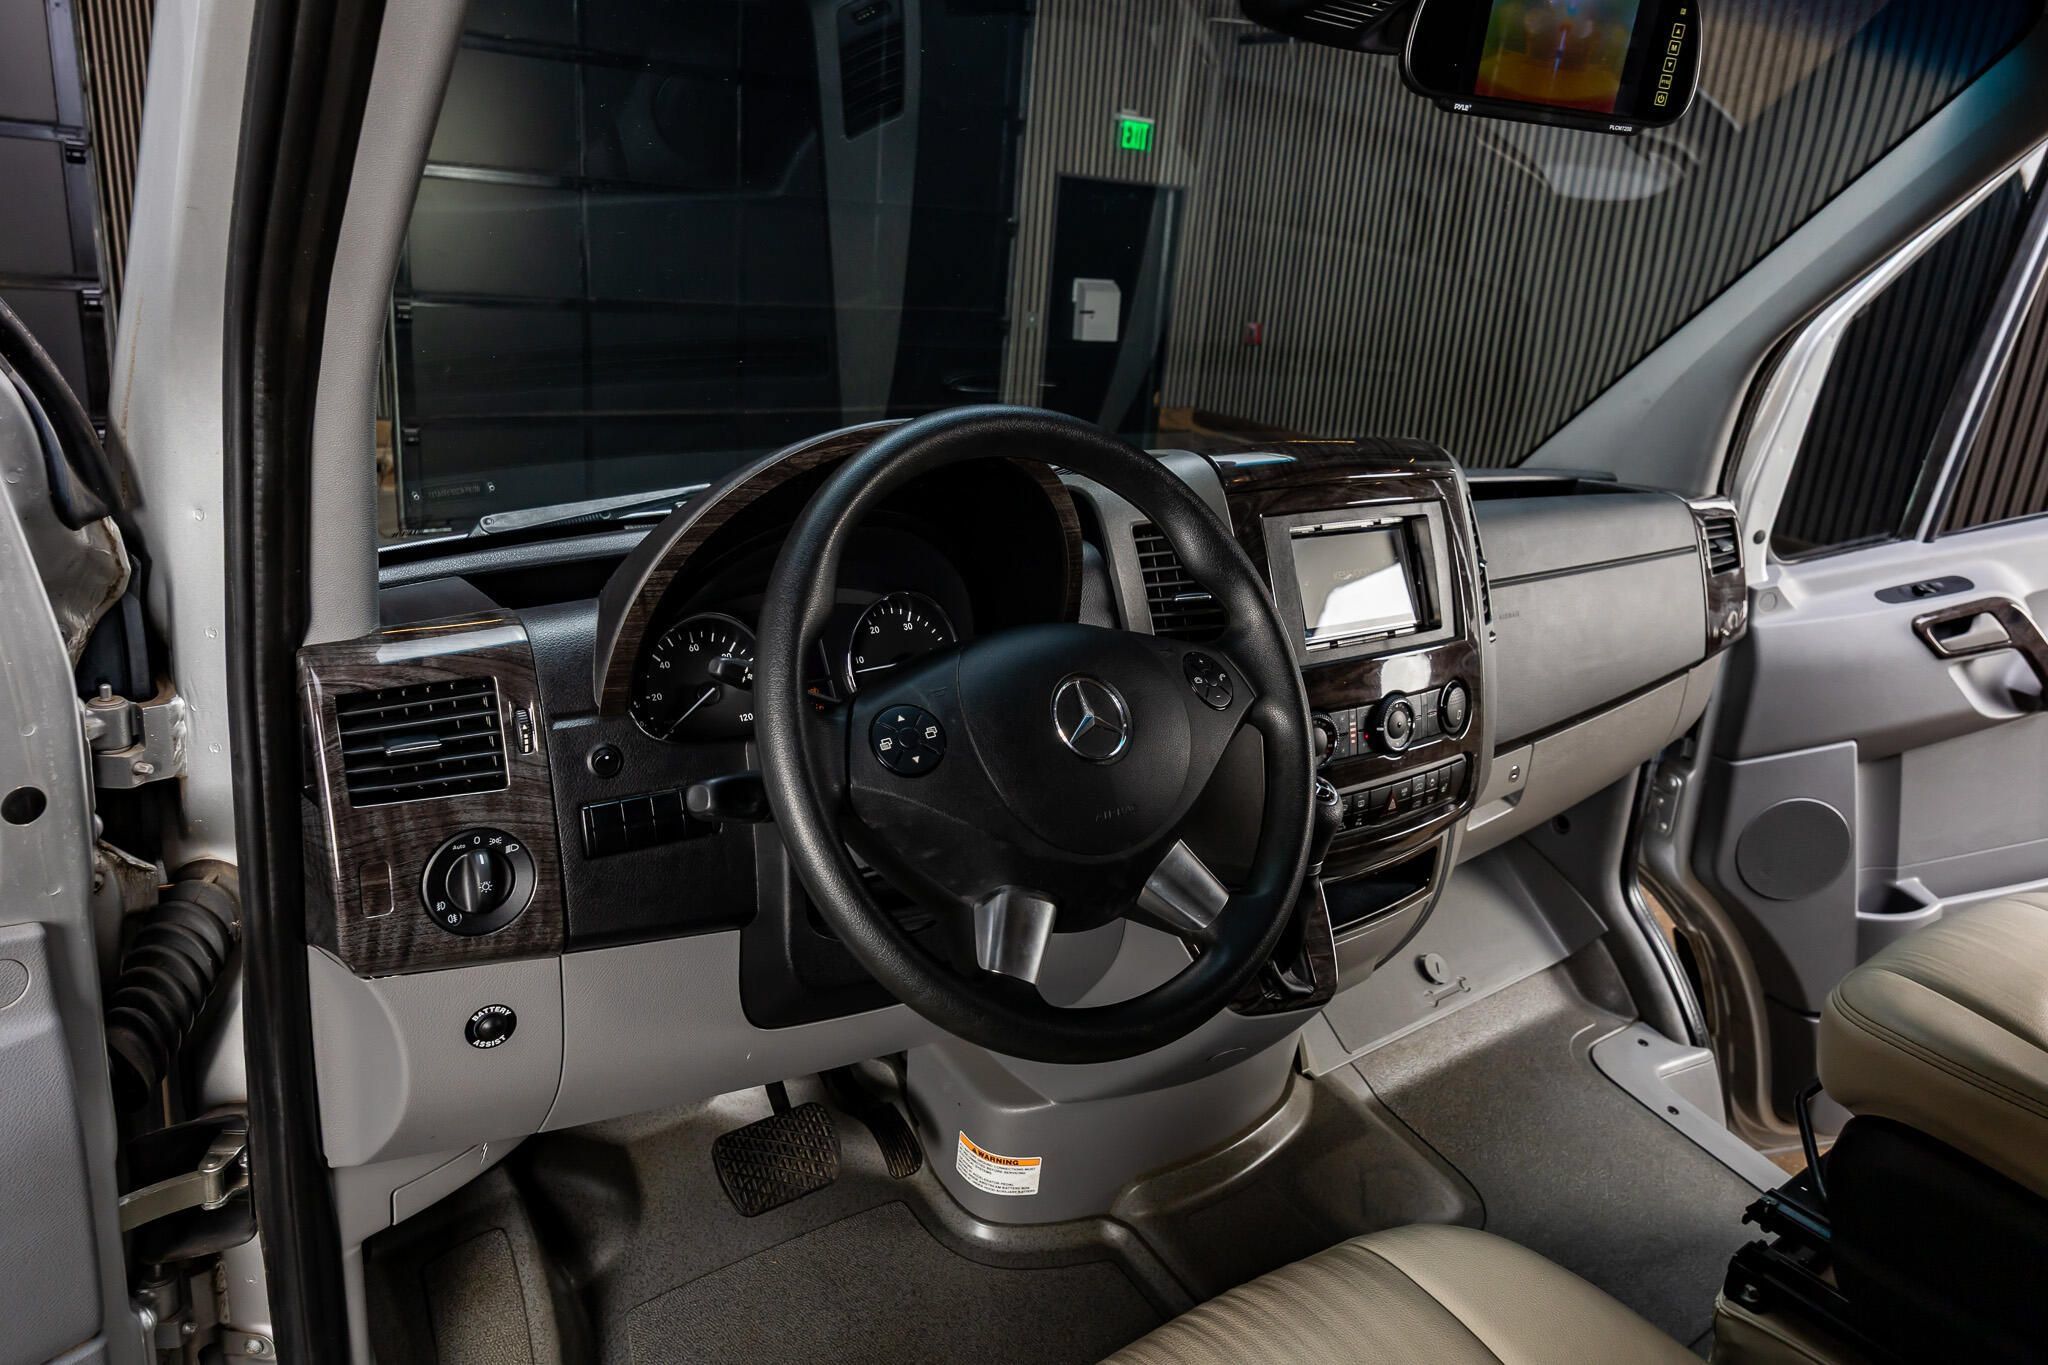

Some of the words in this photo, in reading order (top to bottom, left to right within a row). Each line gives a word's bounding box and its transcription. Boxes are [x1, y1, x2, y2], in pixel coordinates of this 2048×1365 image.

[1122, 120, 1150, 150] EXIT
[869, 626, 880, 635] 20
[903, 623, 913, 631] 30
[688, 644, 700, 652] 60
[855, 656, 865, 664] 10
[660, 661, 671, 669] 40
[651, 693, 663, 702] 20
[739, 712, 754, 722] 120
[471, 1006, 512, 1021] BATTERY
[472, 1034, 506, 1047] ASSIST
[978, 1151, 1019, 1166] WARNING
